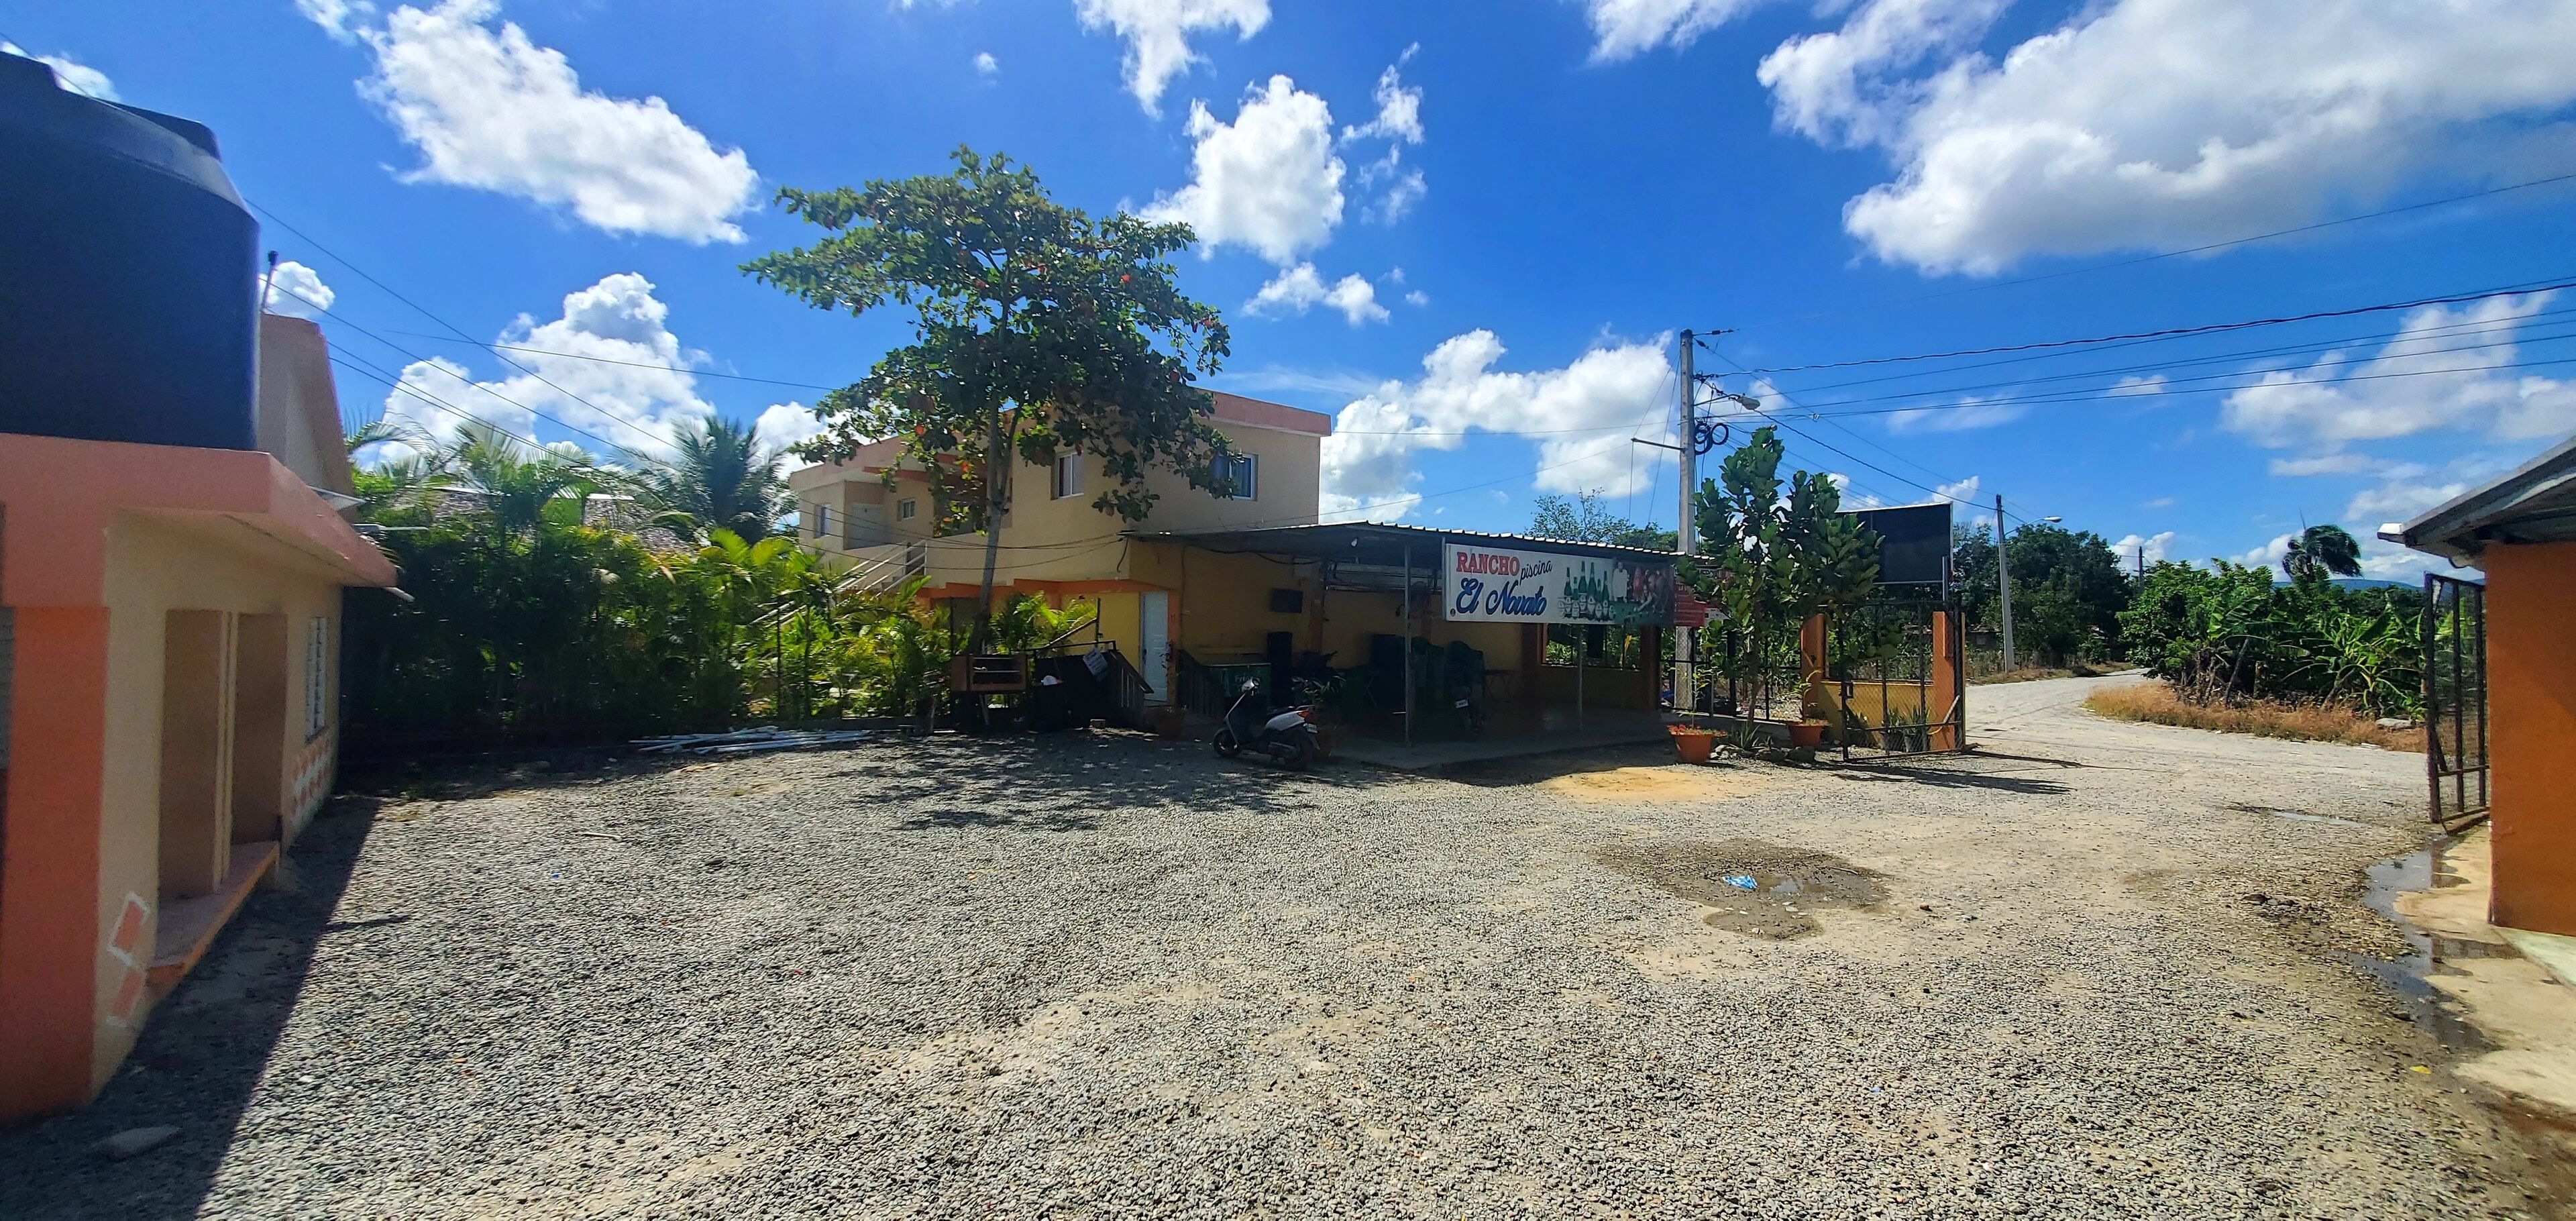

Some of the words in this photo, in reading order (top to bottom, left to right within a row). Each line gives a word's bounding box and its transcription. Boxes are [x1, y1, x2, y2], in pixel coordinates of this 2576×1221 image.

[1456, 552, 1520, 576] RANCHO
[1519, 560, 1553, 586] piscina
[1456, 578, 1484, 614] El
[1485, 580, 1547, 616] Novato
